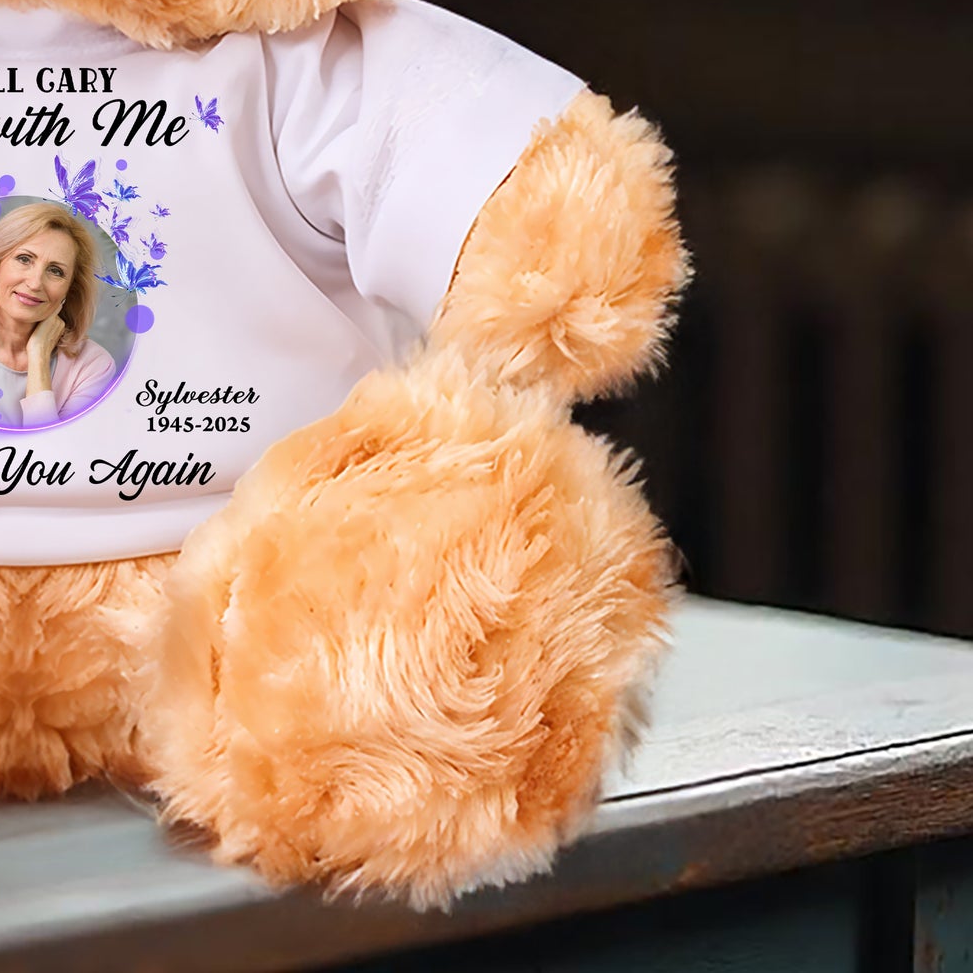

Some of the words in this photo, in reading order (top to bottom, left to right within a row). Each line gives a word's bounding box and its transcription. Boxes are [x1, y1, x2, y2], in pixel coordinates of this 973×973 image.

[35, 67, 117, 94] CARY
[92, 98, 190, 147] Me
[135, 379, 260, 416] Sylvester
[147, 416, 251, 433] 1945-2025
[88, 449, 216, 502] Again
